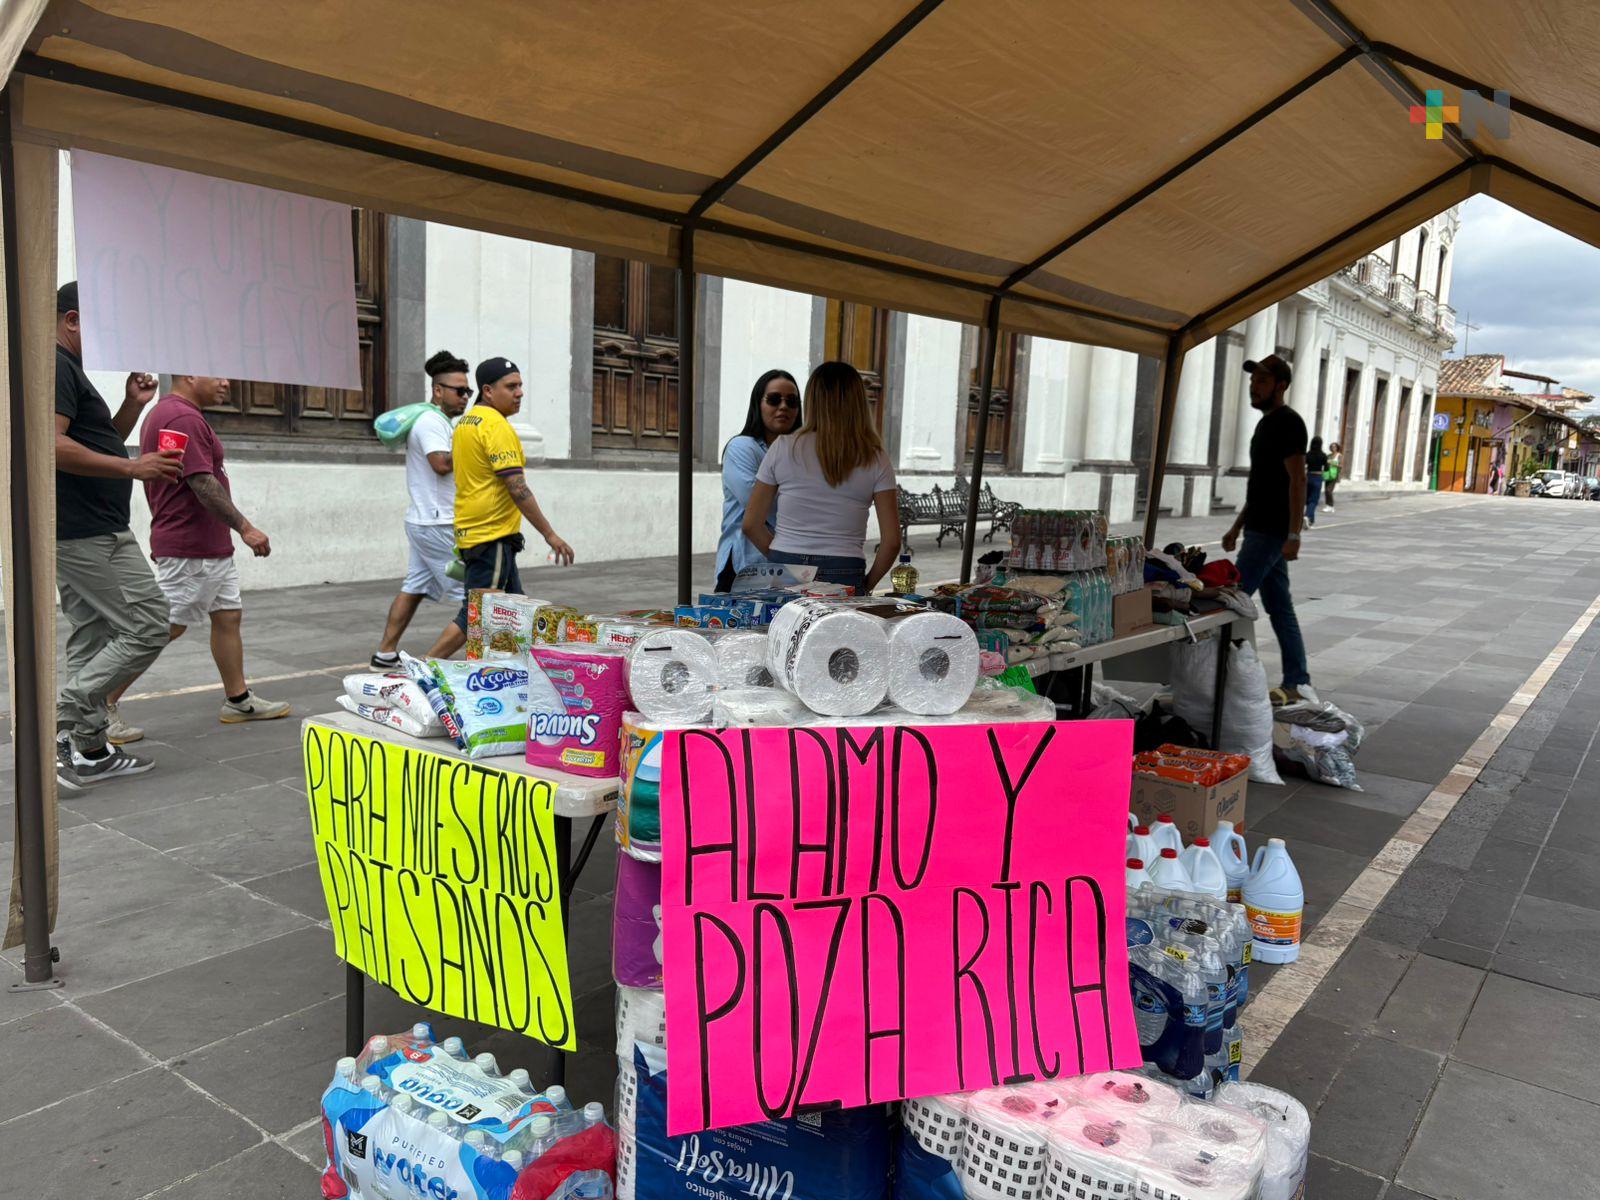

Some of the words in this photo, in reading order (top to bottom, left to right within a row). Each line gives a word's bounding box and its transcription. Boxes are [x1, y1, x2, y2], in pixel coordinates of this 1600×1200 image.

[530, 714, 601, 745] Suavel
[987, 725, 1057, 882] Y
[307, 727, 387, 862] PARA
[401, 750, 554, 903] NUESTROS
[325, 841, 569, 1046] PAISANOS
[693, 894, 905, 1130] POZA
[953, 875, 1114, 1090] RICA
[399, 1077, 464, 1111] agua
